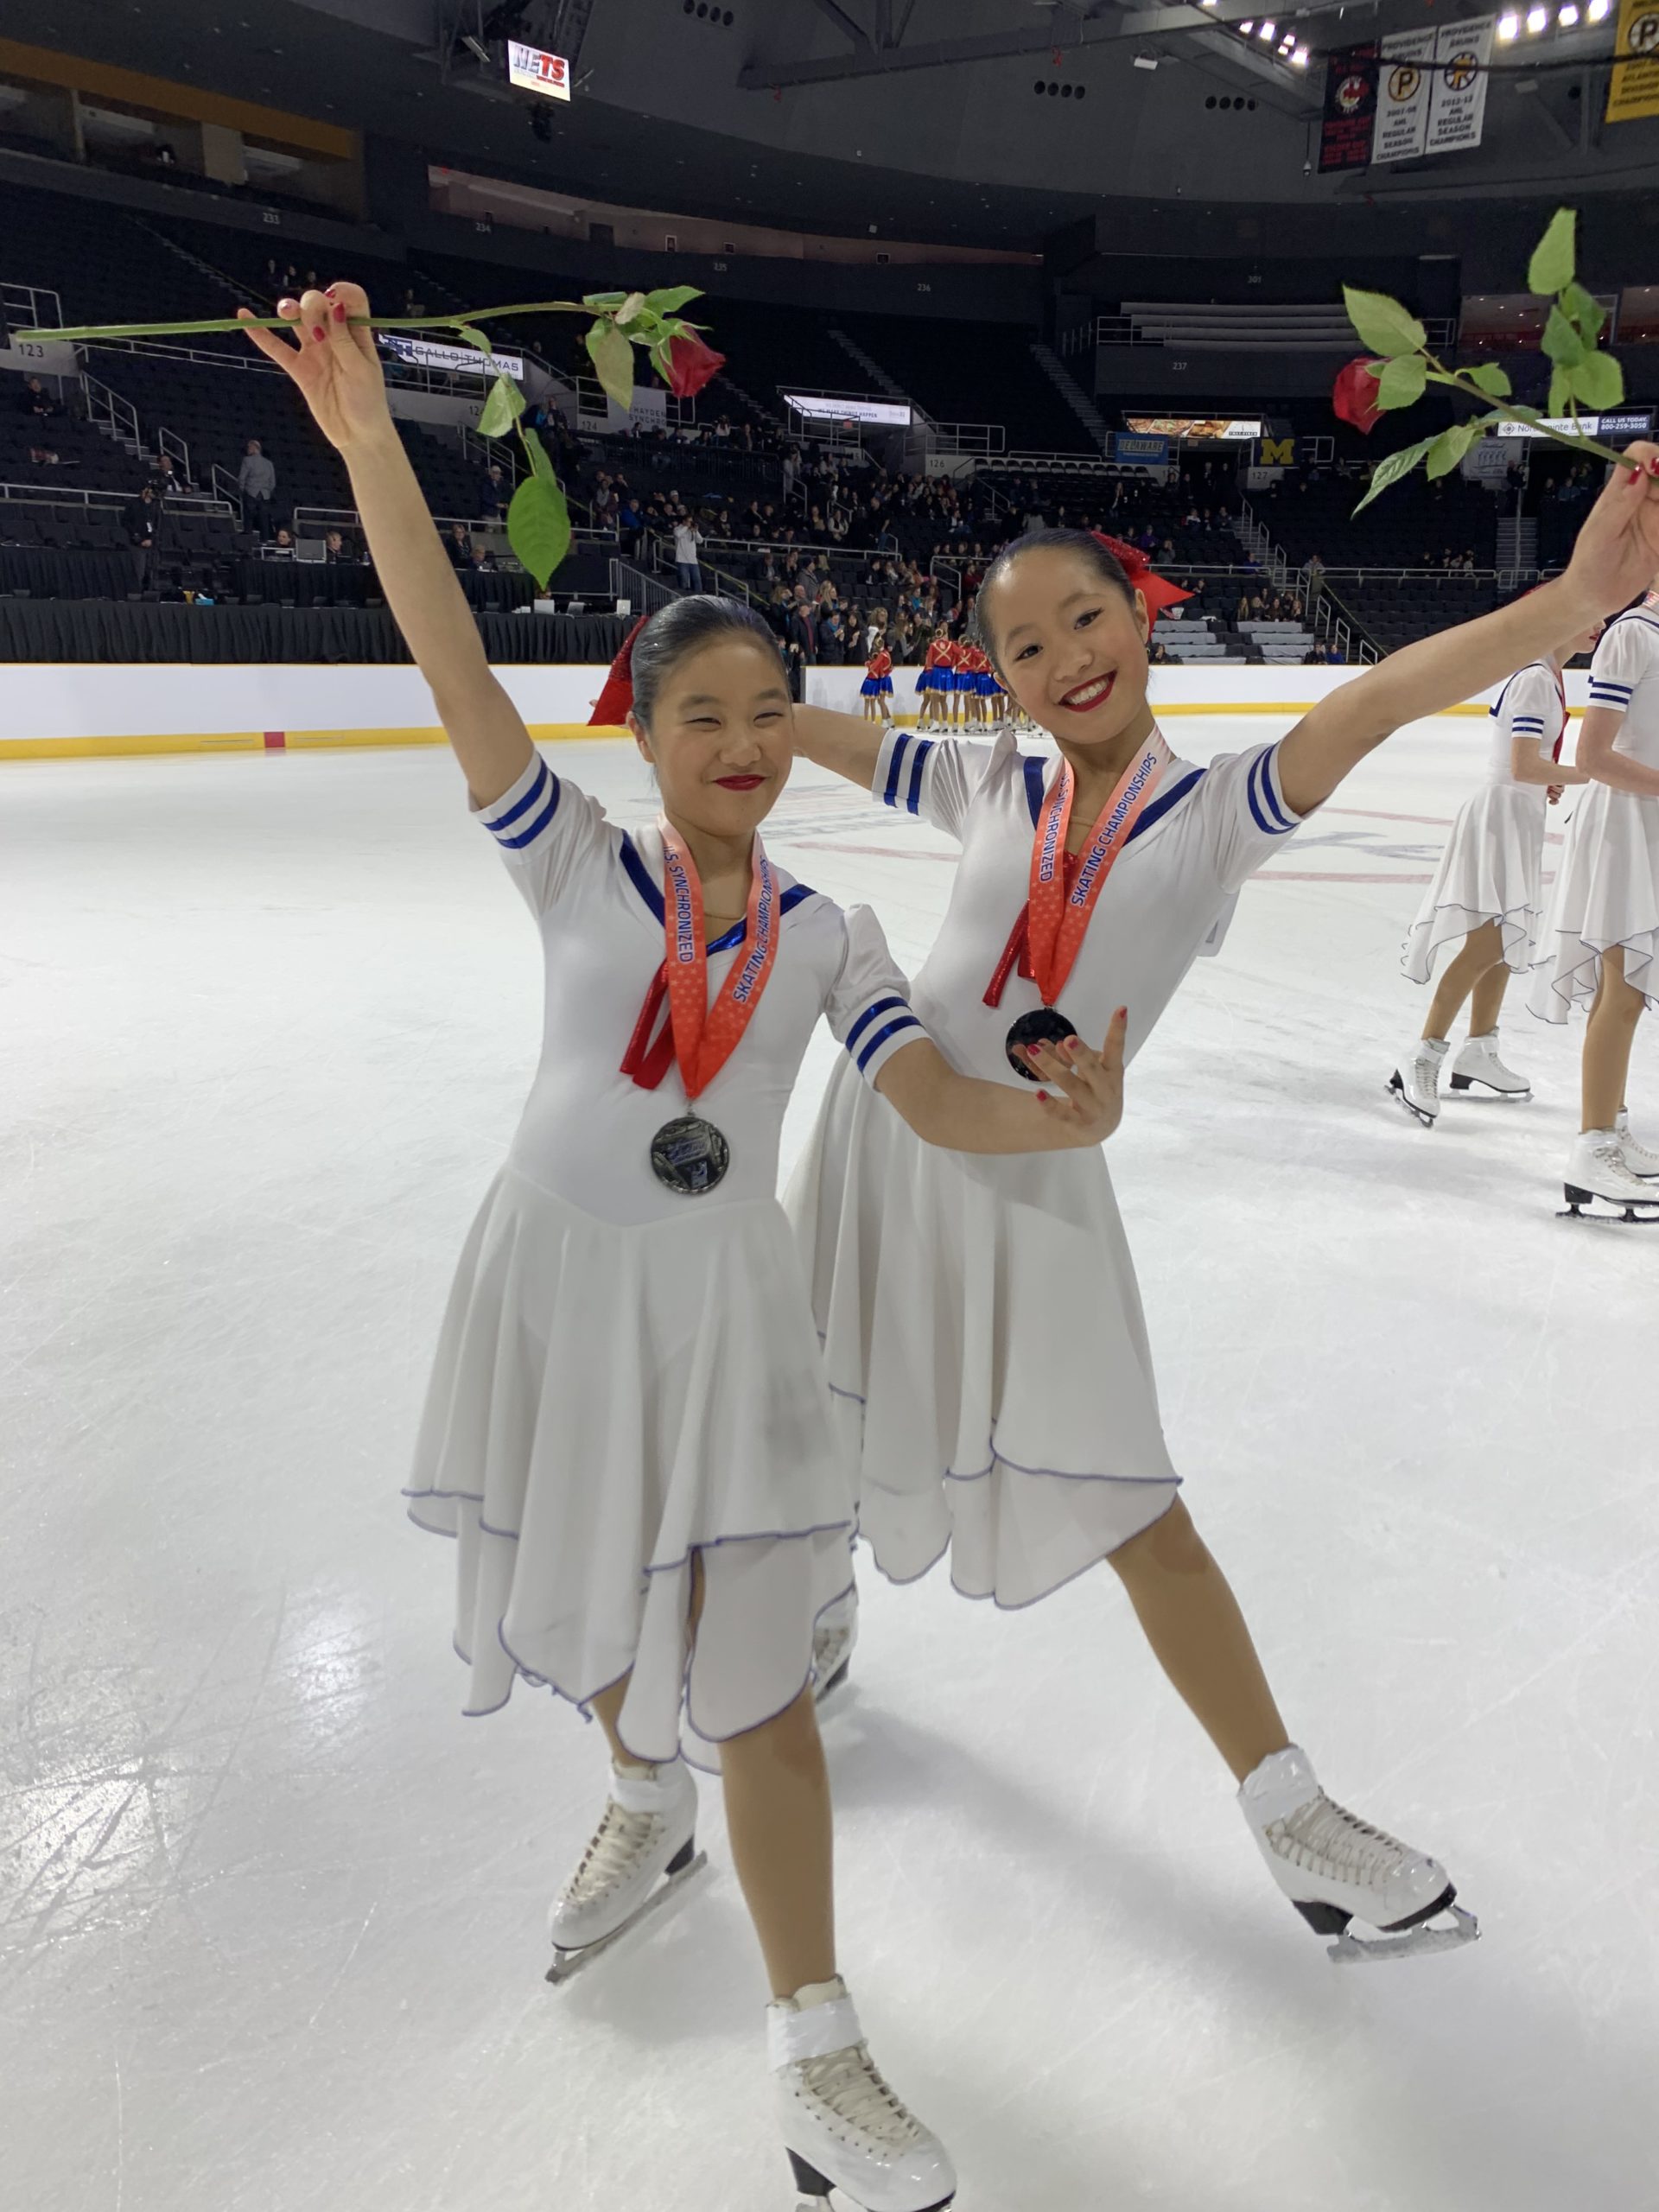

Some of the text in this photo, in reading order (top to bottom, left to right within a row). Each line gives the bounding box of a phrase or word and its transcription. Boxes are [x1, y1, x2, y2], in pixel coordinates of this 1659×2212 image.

[513, 46, 565, 81] NETS
[1438, 124, 1471, 136] SEASON
[1384, 137, 1414, 149] SEASON
[19, 343, 43, 358] 123
[415, 346, 459, 361] GALLO
[469, 405, 483, 416] 12
[582, 421, 597, 430] 124
[1120, 441, 1163, 452] DELAWARE
[1260, 438, 1294, 465] M
[930, 459, 944, 467] 126
[1071, 752, 1157, 906] SKATING CHAMPIONSHIPS
[669, 866, 694, 963] SYNCHRONIZED
[734, 855, 772, 1002] SKATING CHAMPIONSHIPS
